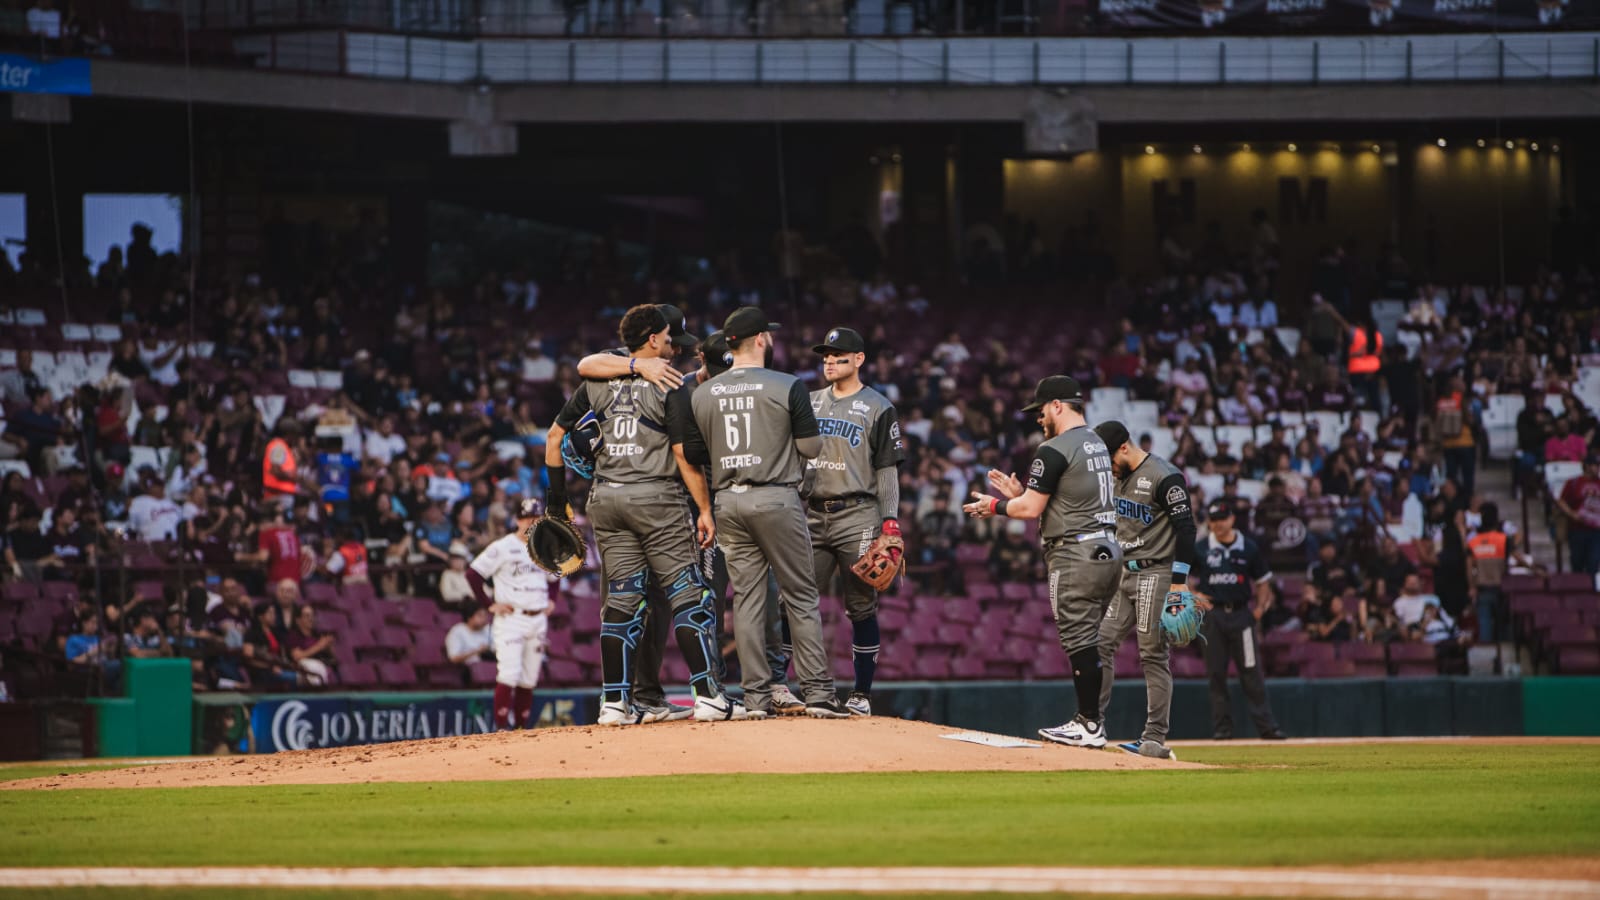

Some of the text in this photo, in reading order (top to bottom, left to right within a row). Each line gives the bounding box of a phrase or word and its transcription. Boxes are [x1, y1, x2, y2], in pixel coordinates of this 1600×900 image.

[723, 412, 751, 452] 61
[815, 417, 864, 448] ASAVE
[720, 454, 754, 470] TECATE
[318, 703, 517, 747] JOYERÍA LUN
